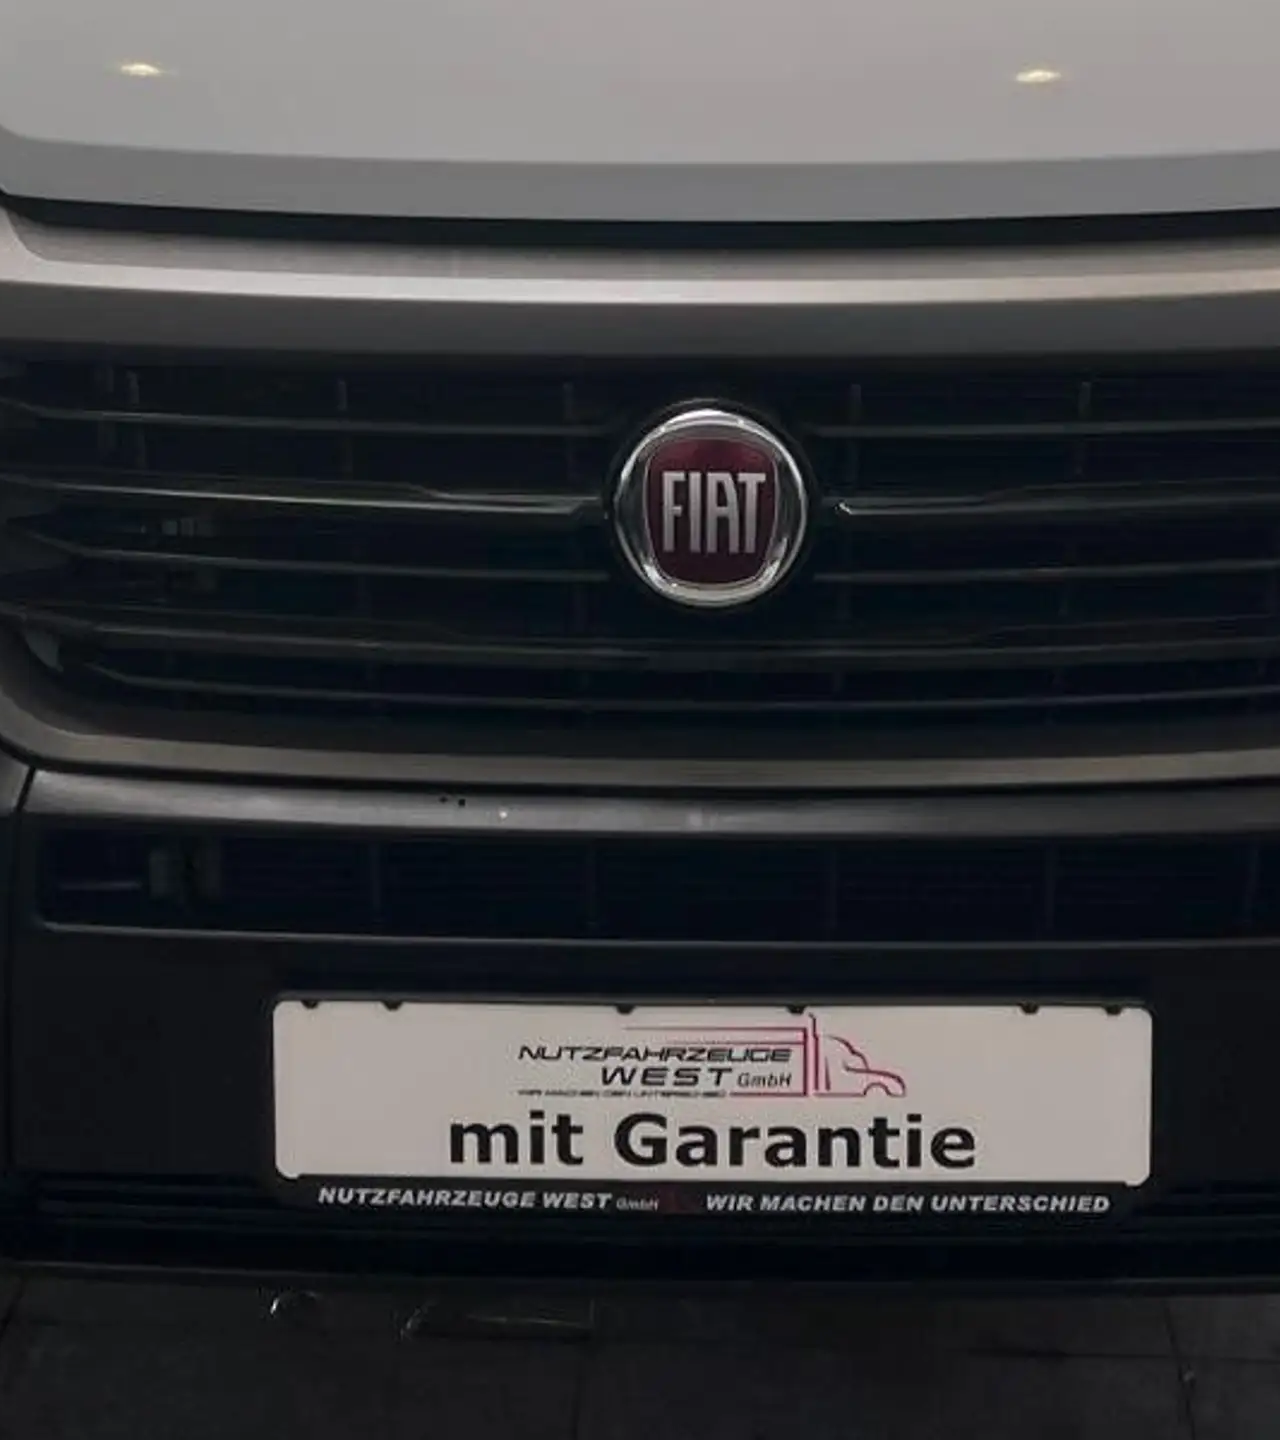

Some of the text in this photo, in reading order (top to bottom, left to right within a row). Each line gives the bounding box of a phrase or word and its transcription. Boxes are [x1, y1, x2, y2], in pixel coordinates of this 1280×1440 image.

[661, 470, 767, 554] FIAT
[518, 1044, 793, 1064] NUTZFAHRZEUGE
[601, 1066, 792, 1089] WEST GmbH
[449, 1110, 976, 1169] mit Garantie
[319, 1186, 536, 1210] NUTZFAHRZEUGE
[542, 1191, 612, 1211] WEST
[706, 1193, 754, 1211] WIR
[759, 1193, 867, 1213] MACHEN
[872, 1194, 926, 1213] DEN
[930, 1195, 1111, 1214] UNTERSCHIED
